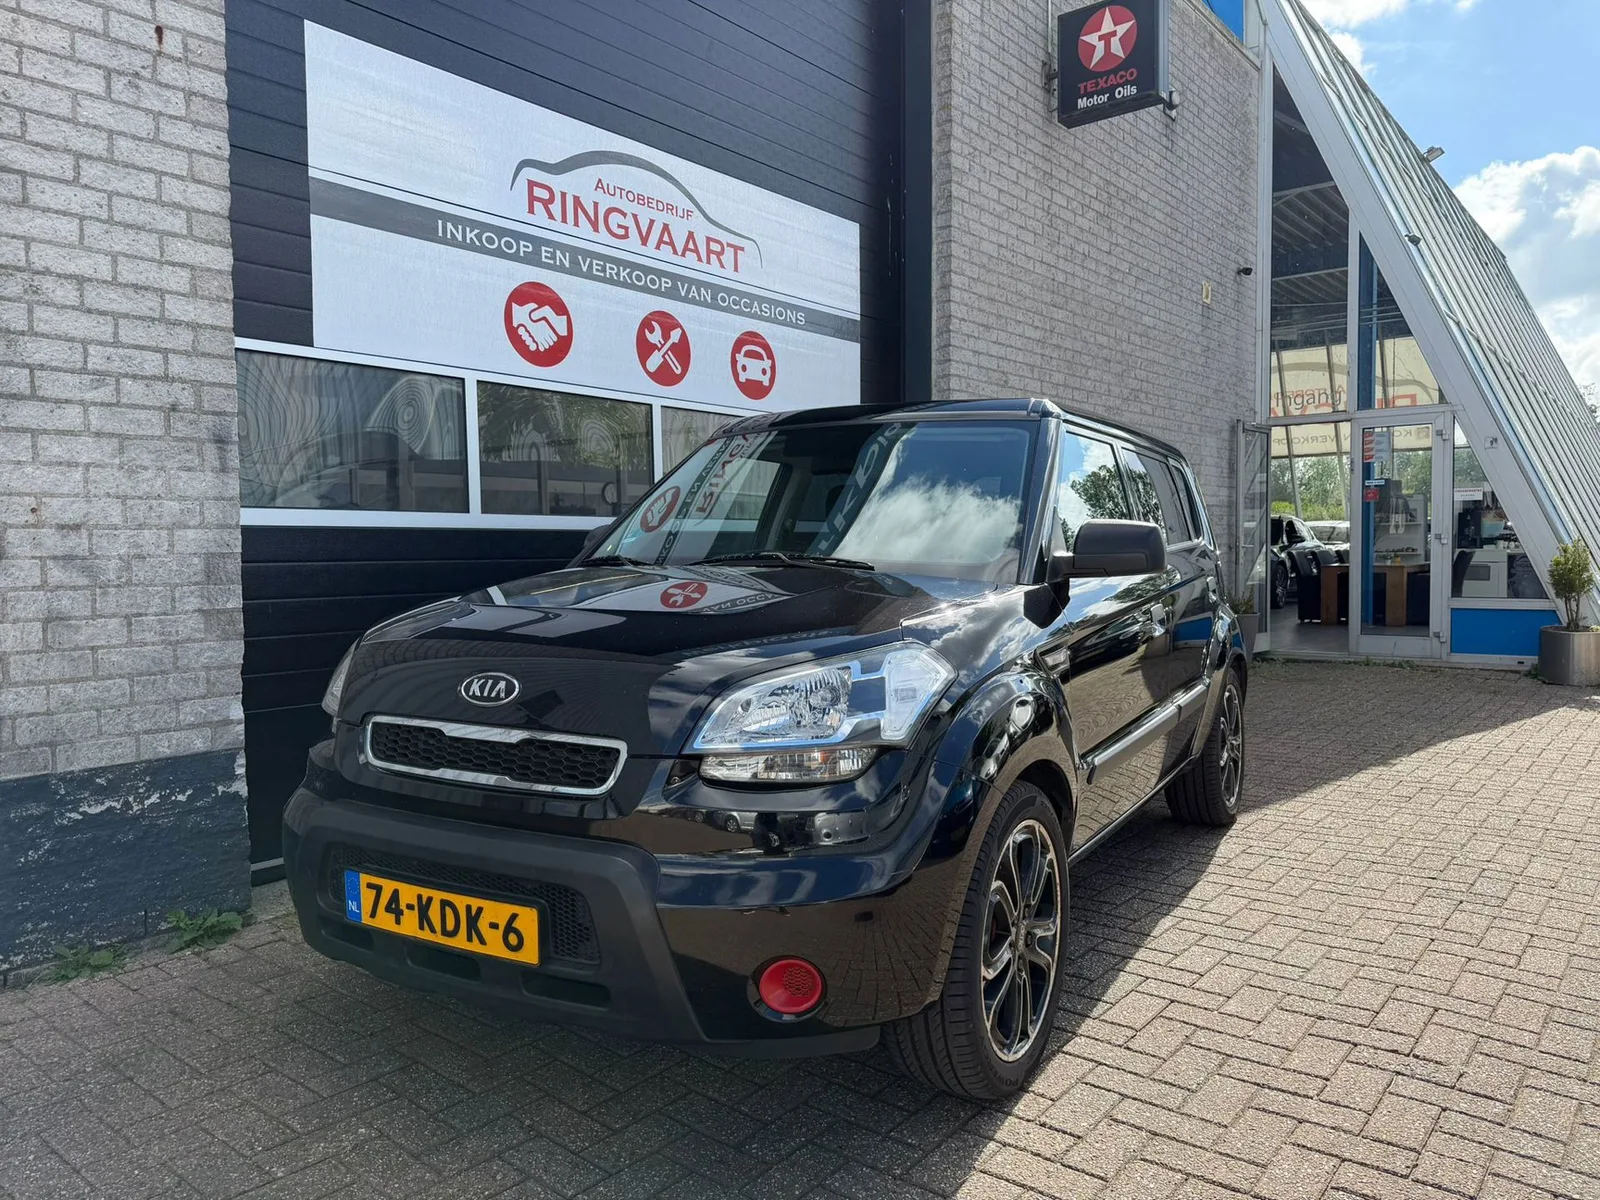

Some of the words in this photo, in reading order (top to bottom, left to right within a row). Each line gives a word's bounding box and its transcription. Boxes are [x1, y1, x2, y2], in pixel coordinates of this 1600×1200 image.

[1077, 93, 1109, 109] Motor
[1115, 85, 1137, 99] Oils
[1078, 67, 1137, 94] TEXACO
[594, 177, 694, 221] AUTOBEDRIJF
[526, 178, 745, 273] RINGVAART
[437, 218, 534, 257] INKOOP
[541, 246, 570, 267] EN
[578, 254, 672, 293] VERKOOP
[677, 282, 712, 303] VAN
[717, 292, 806, 325] OCCASIONS
[468, 678, 506, 698] KIA
[348, 899, 360, 913] NL
[366, 882, 525, 953] 74-KDK-6
